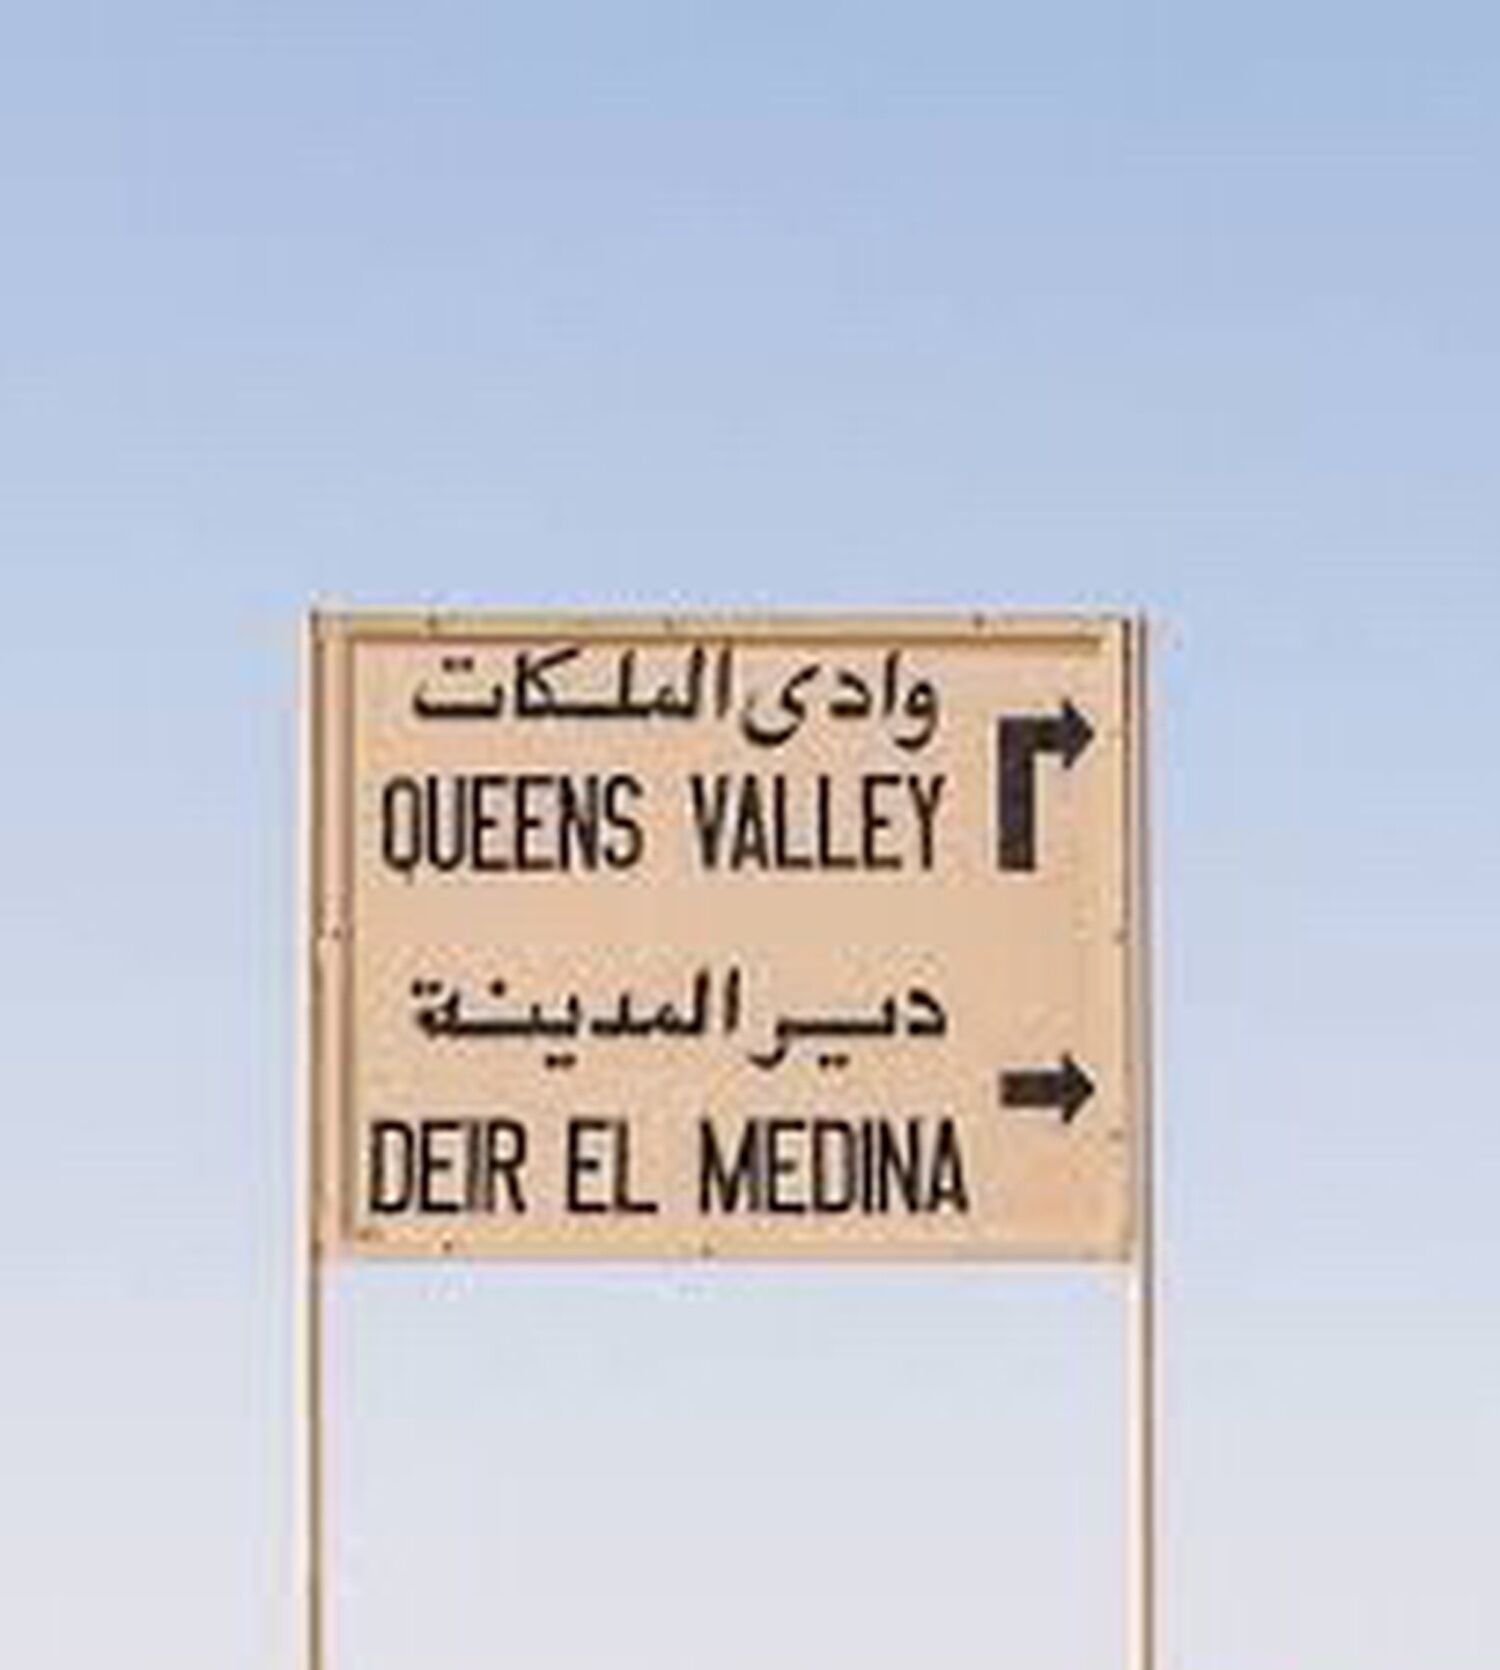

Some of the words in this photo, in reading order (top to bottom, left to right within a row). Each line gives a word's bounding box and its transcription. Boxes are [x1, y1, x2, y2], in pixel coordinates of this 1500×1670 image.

[381, 774, 645, 877] QUEENS
[689, 774, 947, 872] VALLEY
[369, 1117, 528, 1216] DEIR
[566, 1117, 660, 1216] EL
[698, 1117, 970, 1216] MEDINA
